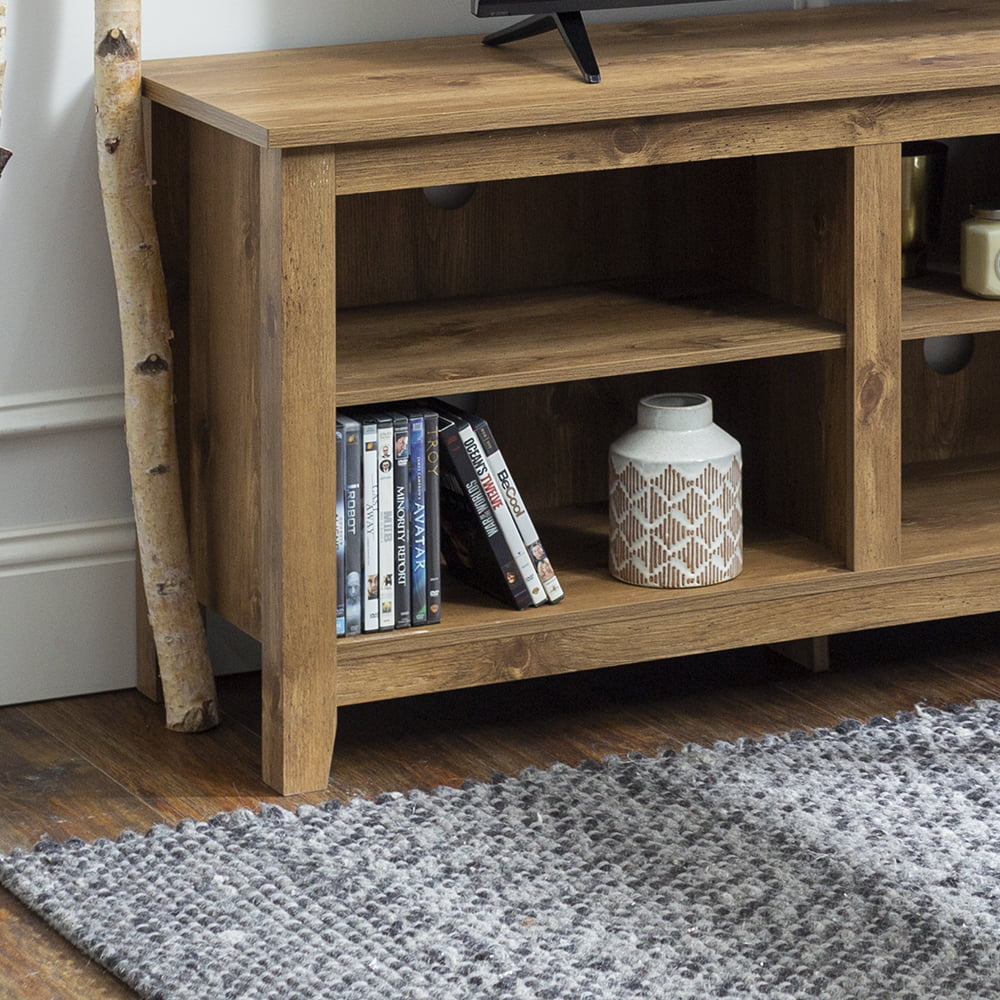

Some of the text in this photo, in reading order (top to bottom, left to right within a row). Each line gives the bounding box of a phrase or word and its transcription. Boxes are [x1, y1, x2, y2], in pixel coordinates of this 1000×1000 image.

[426, 425, 439, 476] TROY
[463, 437, 488, 476] OCEAN'S
[480, 474, 504, 511] TWELVE
[366, 503, 375, 535] AWAY
[465, 479, 487, 515] WORLDS
[396, 486, 407, 587] MINORITY REPORT
[413, 502, 426, 573] AVATAR
[481, 515, 499, 538] WAR
